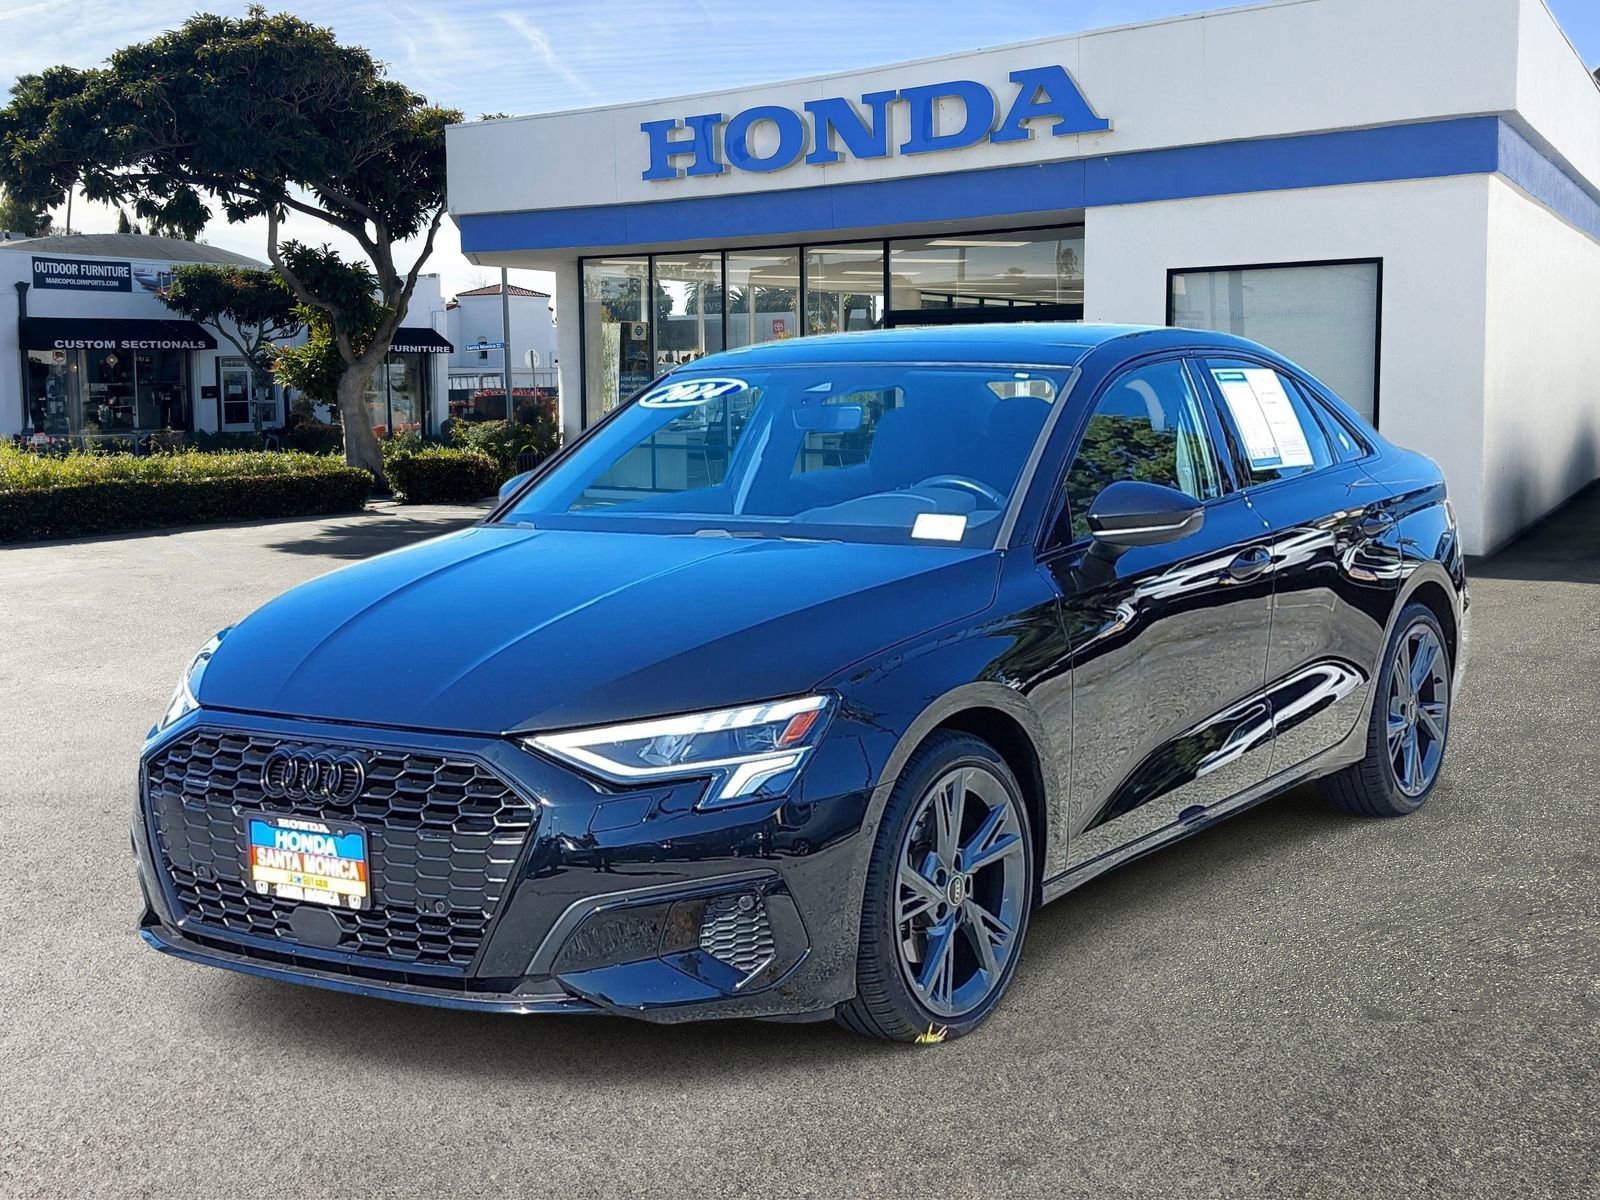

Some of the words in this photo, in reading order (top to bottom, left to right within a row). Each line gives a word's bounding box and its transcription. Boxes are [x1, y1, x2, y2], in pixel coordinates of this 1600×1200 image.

[640, 64, 1114, 181] HONDA
[34, 261, 79, 275] OUTDOOR
[80, 264, 130, 277] FURNITURE
[45, 277, 119, 287] MARCOPOLOIMPORTS.COM
[54, 339, 116, 349] CUSTOM
[121, 340, 206, 349] SECTIONALS
[388, 344, 451, 353] FURNITURE
[274, 829, 338, 857] HONDA
[256, 847, 303, 873] SANTA
[303, 852, 360, 881] MONICA
